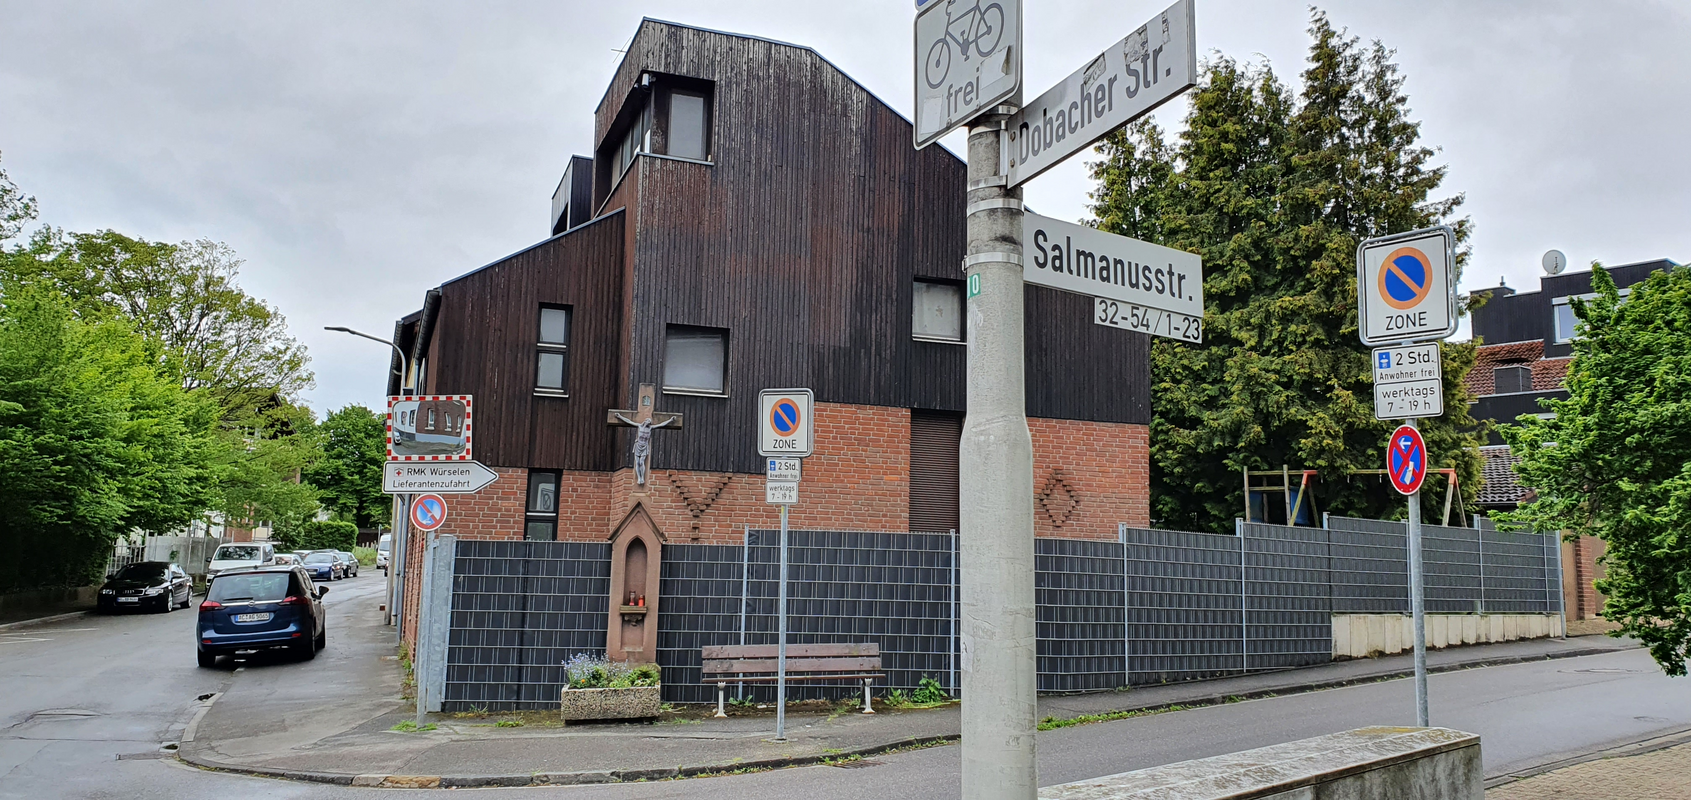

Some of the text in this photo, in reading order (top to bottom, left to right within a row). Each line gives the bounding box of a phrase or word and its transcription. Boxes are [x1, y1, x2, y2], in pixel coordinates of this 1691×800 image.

[946, 67, 981, 118] frei
[1019, 45, 1171, 166] Dobacher Str.
[1033, 228, 1193, 302] Salmanusstr.
[1385, 311, 1428, 331] ZONE
[1395, 350, 1434, 366] 2 Std.
[1379, 367, 1435, 381] Anwohner frei
[1381, 386, 1435, 398] werktags
[1387, 402, 1394, 413] 7
[1408, 400, 1419, 411] 19
[1423, 400, 1431, 410] h
[773, 439, 797, 449] ZONE
[407, 467, 471, 477] RMK Würselen
[778, 462, 783, 471] 2
[393, 480, 471, 489] Lieferantenzufahrt
[769, 485, 795, 493] werktags
